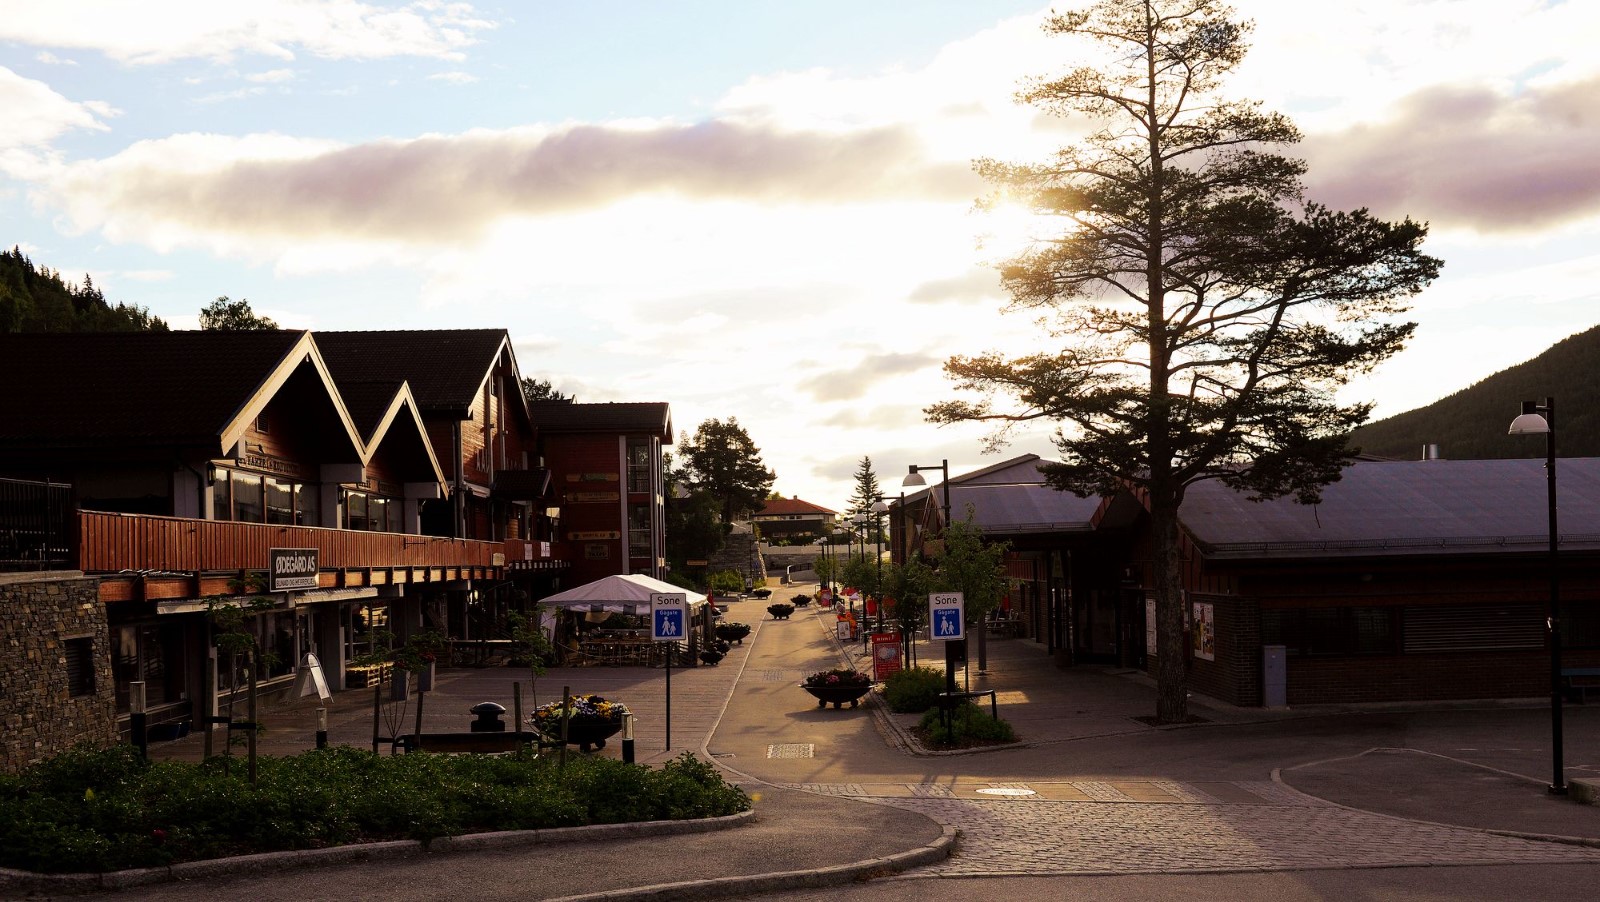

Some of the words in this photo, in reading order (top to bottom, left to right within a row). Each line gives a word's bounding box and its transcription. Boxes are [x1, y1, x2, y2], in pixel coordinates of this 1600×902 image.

[276, 551, 307, 574] ØDEGÅRD
[307, 556, 316, 572] AS
[657, 596, 680, 605] Sone
[935, 596, 958, 605] Sone
